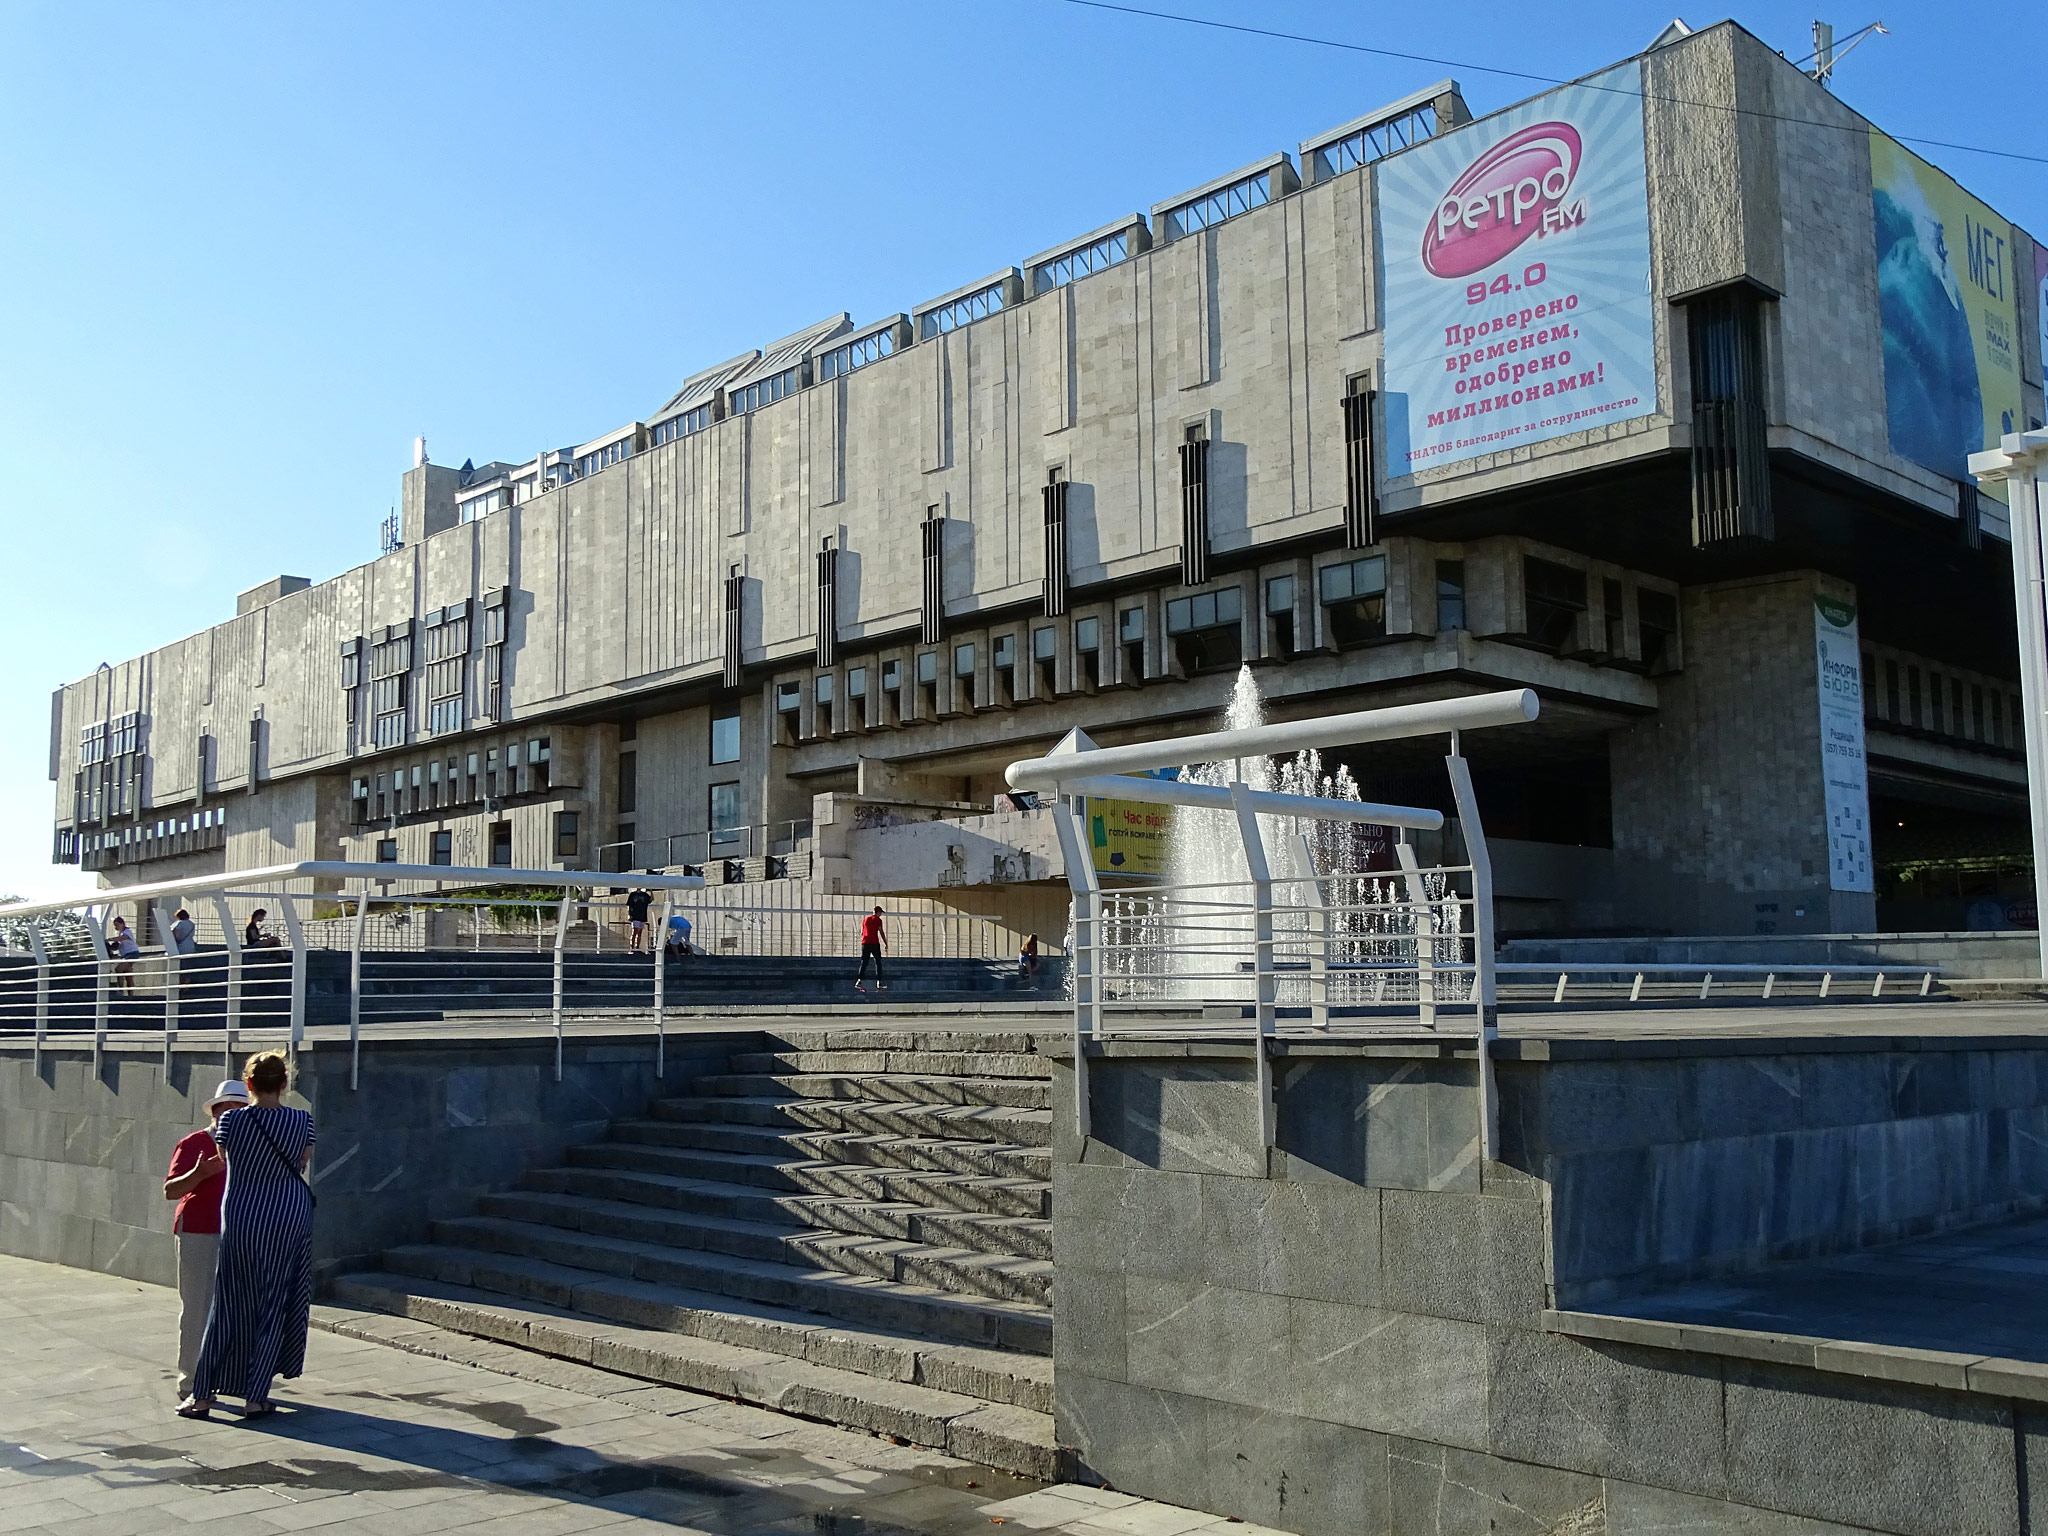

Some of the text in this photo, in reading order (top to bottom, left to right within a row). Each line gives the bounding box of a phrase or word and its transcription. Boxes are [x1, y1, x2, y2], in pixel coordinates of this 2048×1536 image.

[1541, 196, 1588, 234] FM
[1965, 213, 2004, 302] МЕГ
[1466, 262, 1547, 306] 94.0
[1445, 293, 1579, 346] Проверено
[1986, 327, 2011, 354] IMAX
[1445, 320, 1579, 373] временем,
[1427, 362, 1605, 428] миллионами!
[1454, 349, 1572, 395] одобрено
[1405, 395, 1640, 463] ХНАТОБ благодарит за сотрудничество
[1123, 809, 1142, 825] Час
